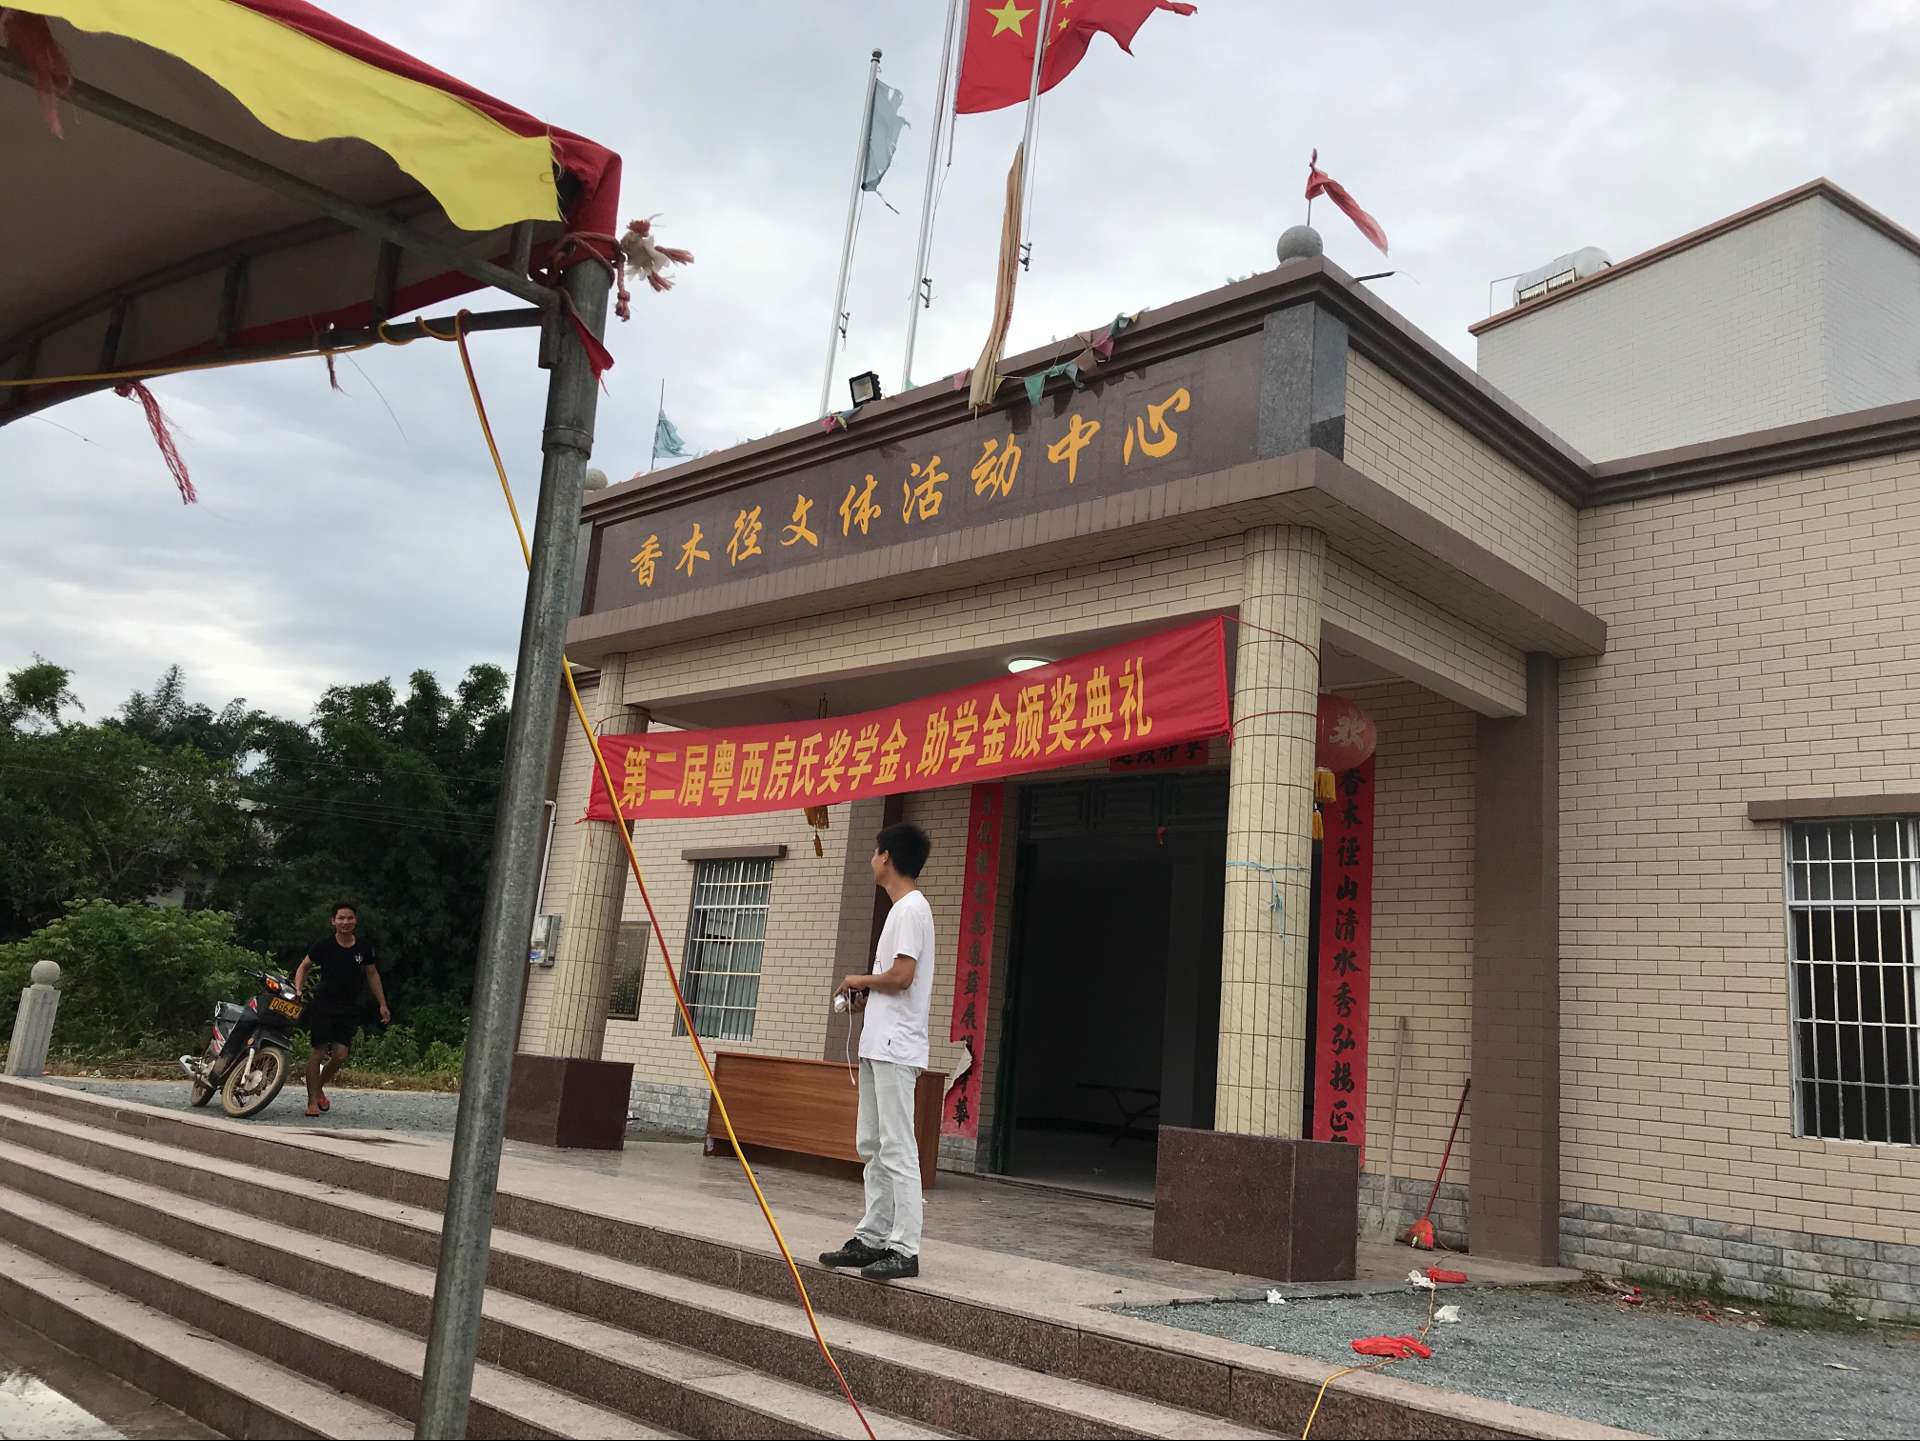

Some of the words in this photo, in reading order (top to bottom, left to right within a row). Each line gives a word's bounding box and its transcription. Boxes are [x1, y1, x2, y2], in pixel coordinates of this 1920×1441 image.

[630, 388, 1191, 588] 香木径文体活动中心
[620, 656, 1153, 810] 第二届粤西房氏奖学金、助学金颁奖典礼
